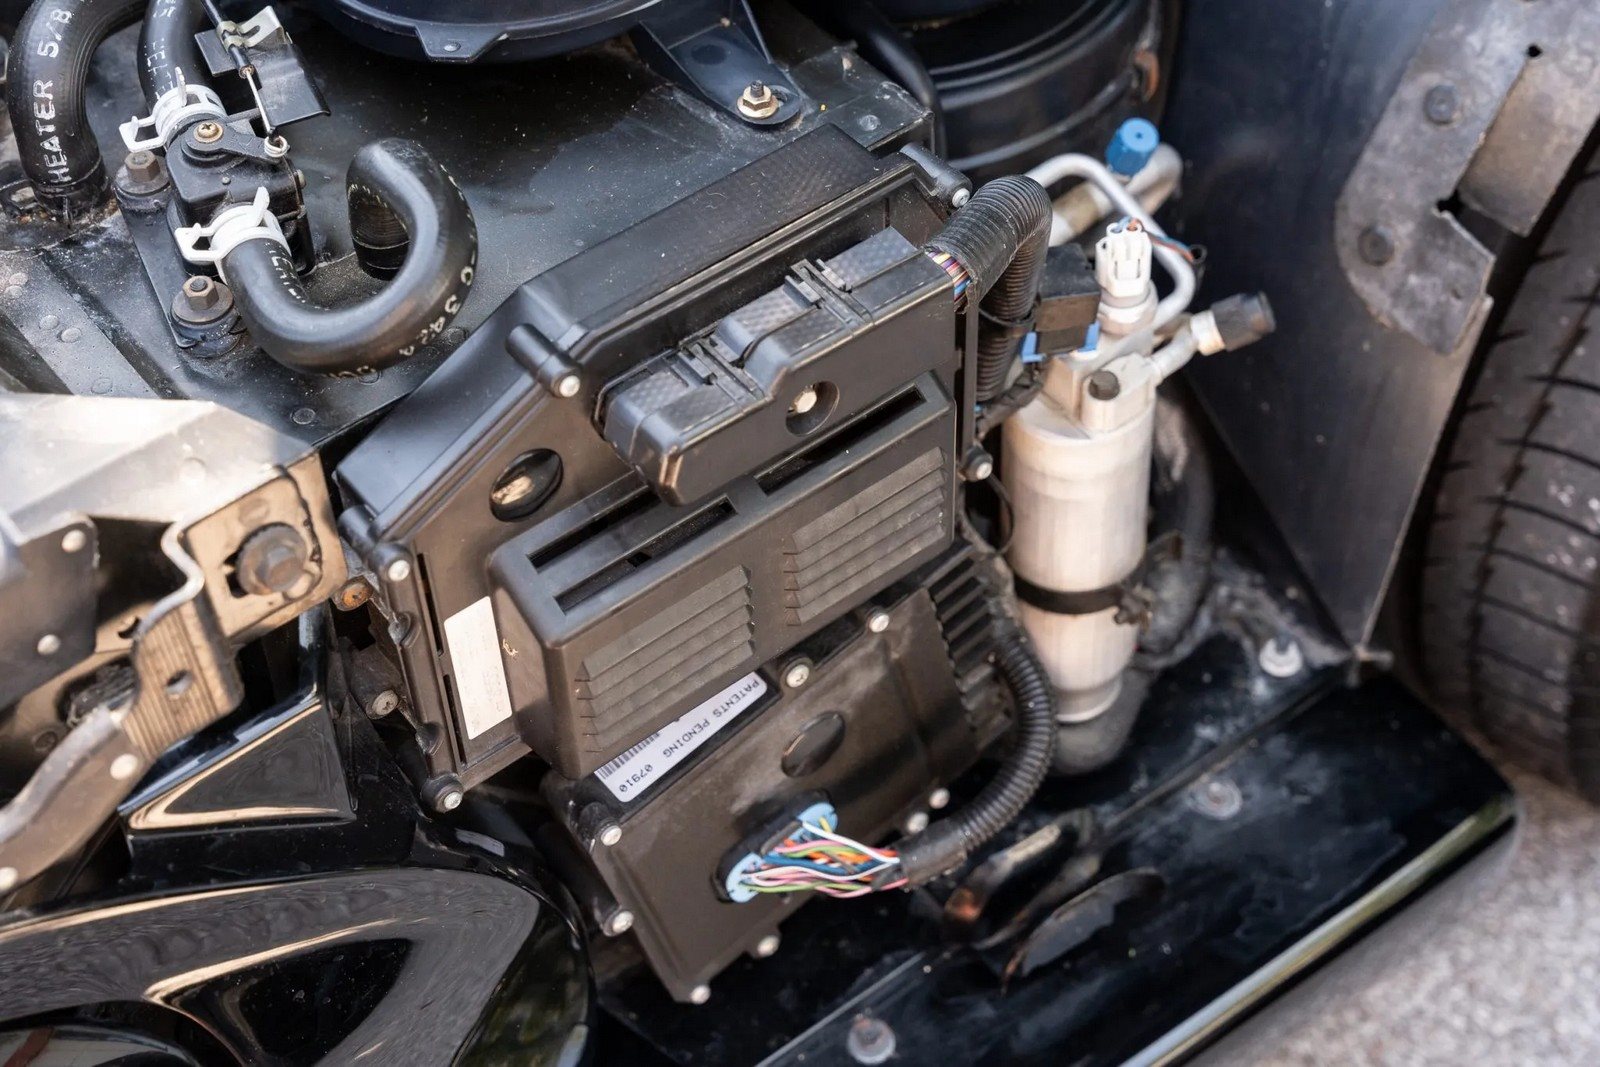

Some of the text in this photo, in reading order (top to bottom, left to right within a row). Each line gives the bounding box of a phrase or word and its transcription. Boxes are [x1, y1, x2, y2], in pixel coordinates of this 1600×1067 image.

[33, 8, 73, 184] HEATER 5/8
[619, 679, 760, 793] PATENTS PENDING 07910
